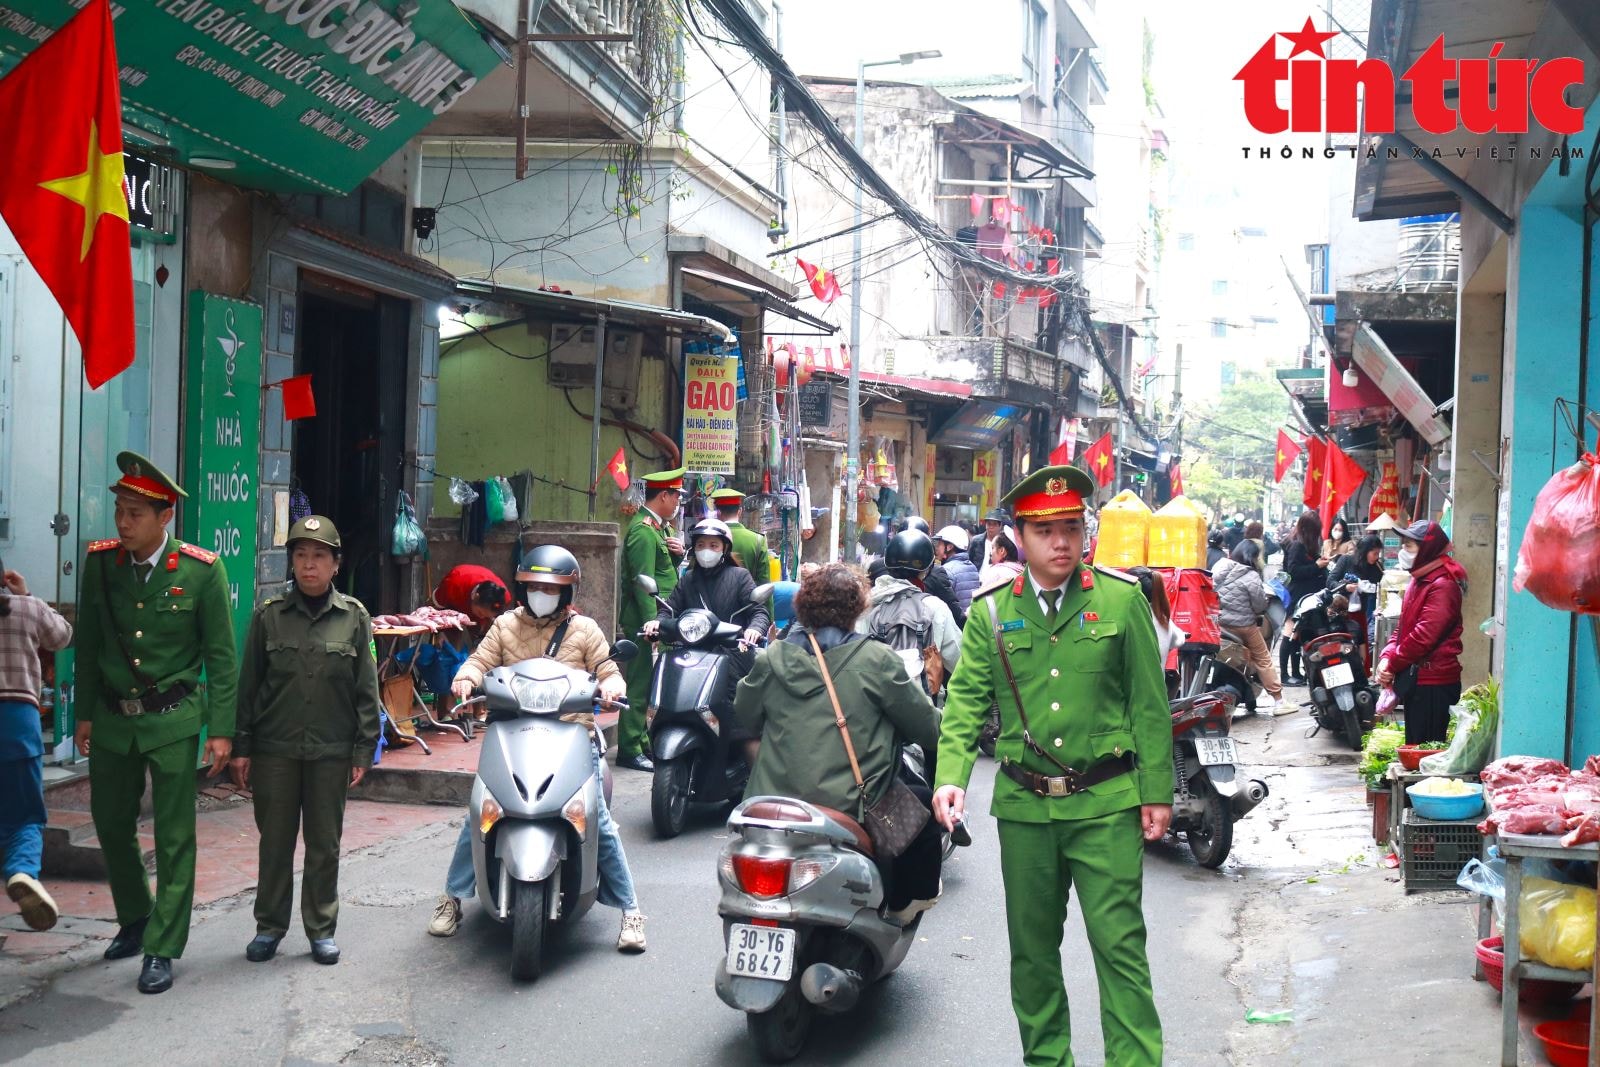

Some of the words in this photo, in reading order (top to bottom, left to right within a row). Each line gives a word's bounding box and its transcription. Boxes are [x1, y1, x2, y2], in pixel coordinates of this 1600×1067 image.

[193, 8, 251, 46] BÁN
[254, 42, 326, 85] THUỐC
[305, 70, 367, 112] THÀNH
[350, 97, 400, 132] PHẨM
[384, 45, 463, 107] ANH
[687, 380, 735, 417] GẠO
[216, 410, 242, 446] NHÀ
[207, 461, 249, 502] THUỐC
[214, 519, 241, 557] ĐỨC
[1201, 739, 1231, 751] 30-N6
[1204, 751, 1234, 763] 2575
[739, 929, 785, 953] 30-Y6
[736, 951, 782, 976] 6847
